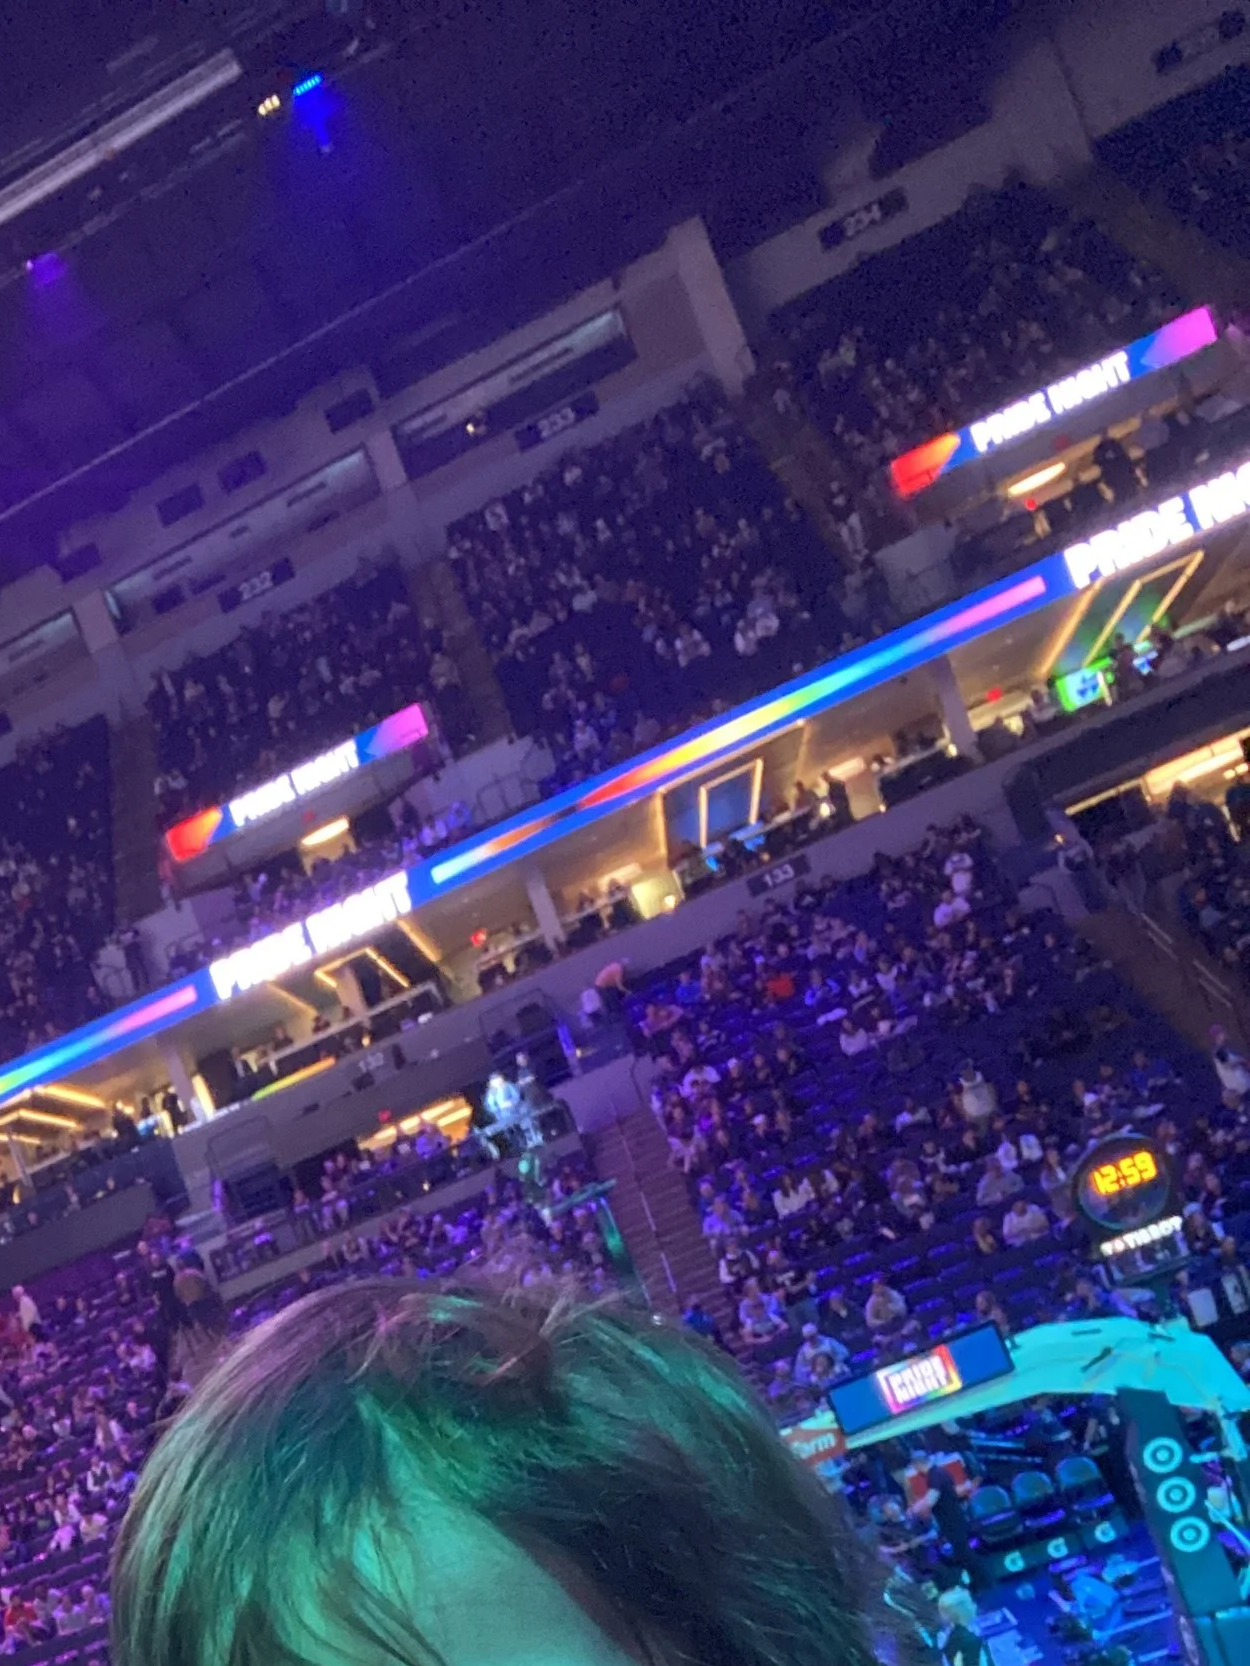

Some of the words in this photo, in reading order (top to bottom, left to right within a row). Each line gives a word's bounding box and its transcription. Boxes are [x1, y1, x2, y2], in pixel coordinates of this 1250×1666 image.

[969, 391, 1051, 453] PRIDE
[1047, 351, 1130, 415] NIGHT
[1064, 495, 1194, 590] PRIDE
[237, 571, 273, 600] 232
[1092, 1150, 1158, 1195] 12:59
